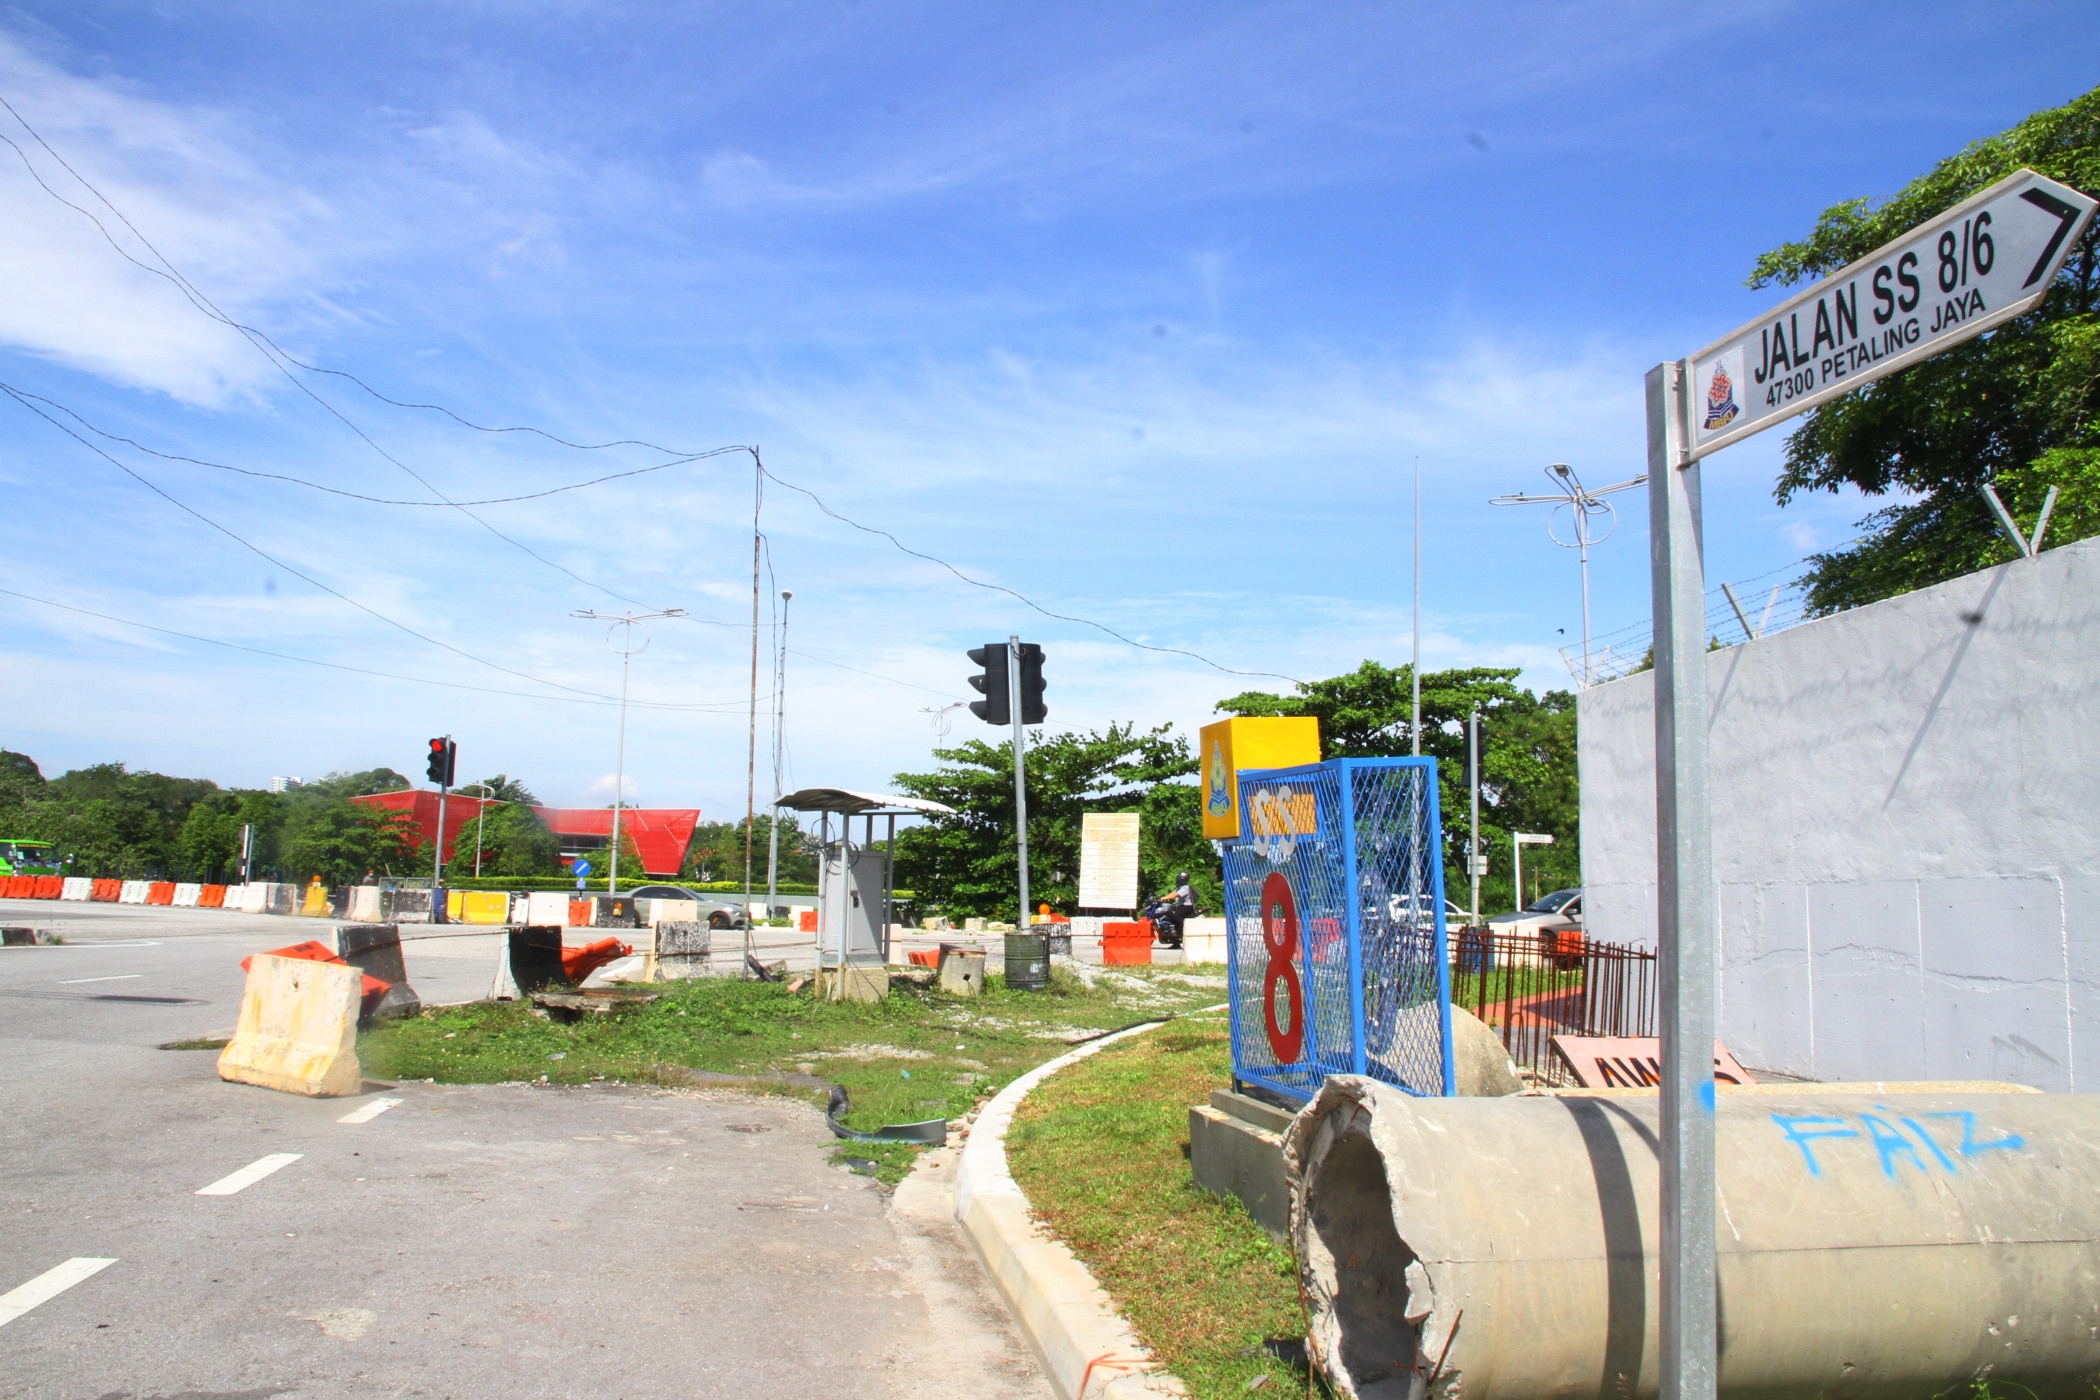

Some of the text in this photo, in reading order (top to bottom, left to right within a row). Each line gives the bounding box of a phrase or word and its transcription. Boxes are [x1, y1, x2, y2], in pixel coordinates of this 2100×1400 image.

[1754, 210, 1995, 385] JALAN SS 8/6
[1766, 287, 1987, 407] 47300 PETALING JAYA
[1708, 409, 1736, 430] MBPJ
[1253, 785, 1297, 858] SS
[1261, 871, 1304, 1066] 8
